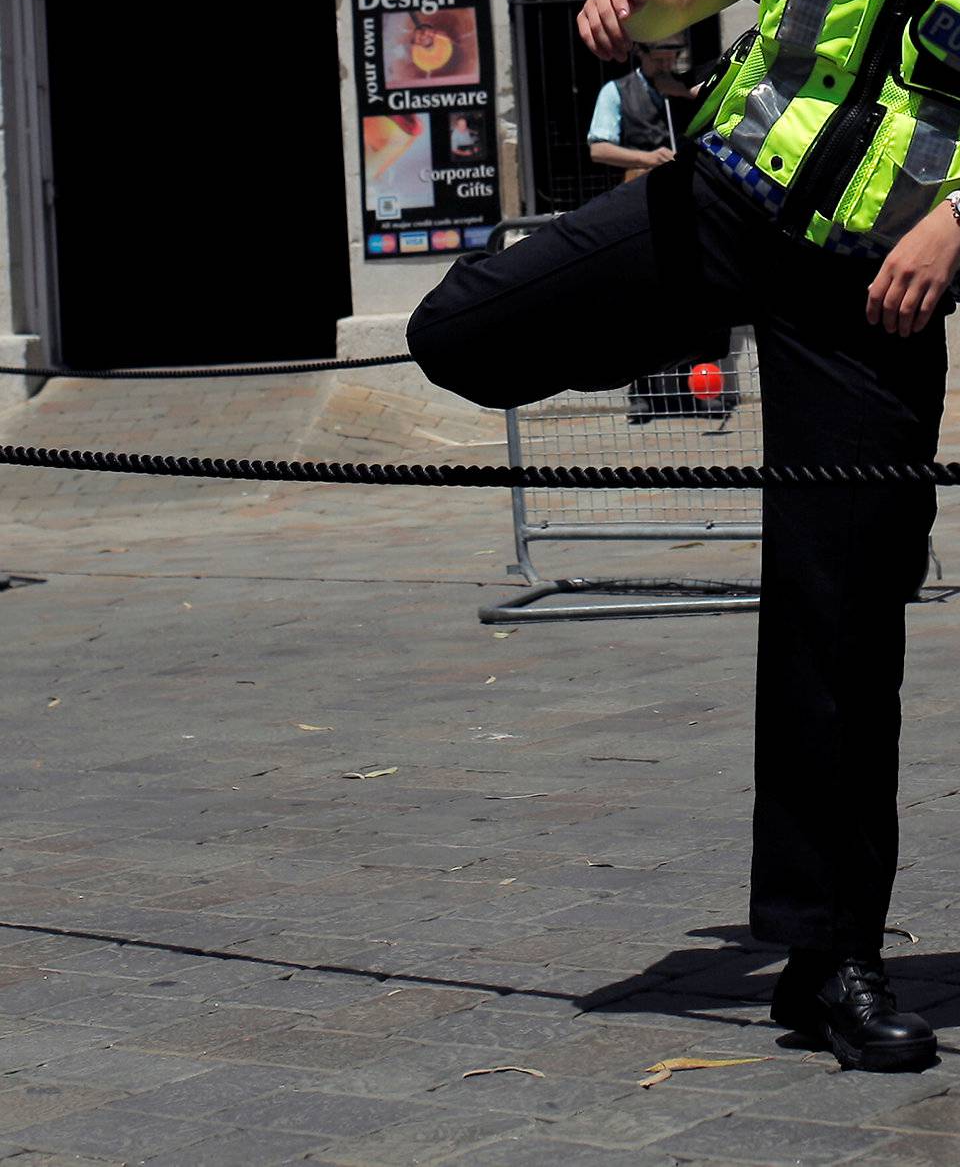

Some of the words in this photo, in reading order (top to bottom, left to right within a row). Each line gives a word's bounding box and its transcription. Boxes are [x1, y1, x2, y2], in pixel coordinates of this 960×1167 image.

[363, 18, 376, 57] own
[364, 62, 383, 104] your
[388, 90, 487, 110] Glassware
[420, 165, 495, 185] Corporate
[457, 183, 493, 198] Gifts
